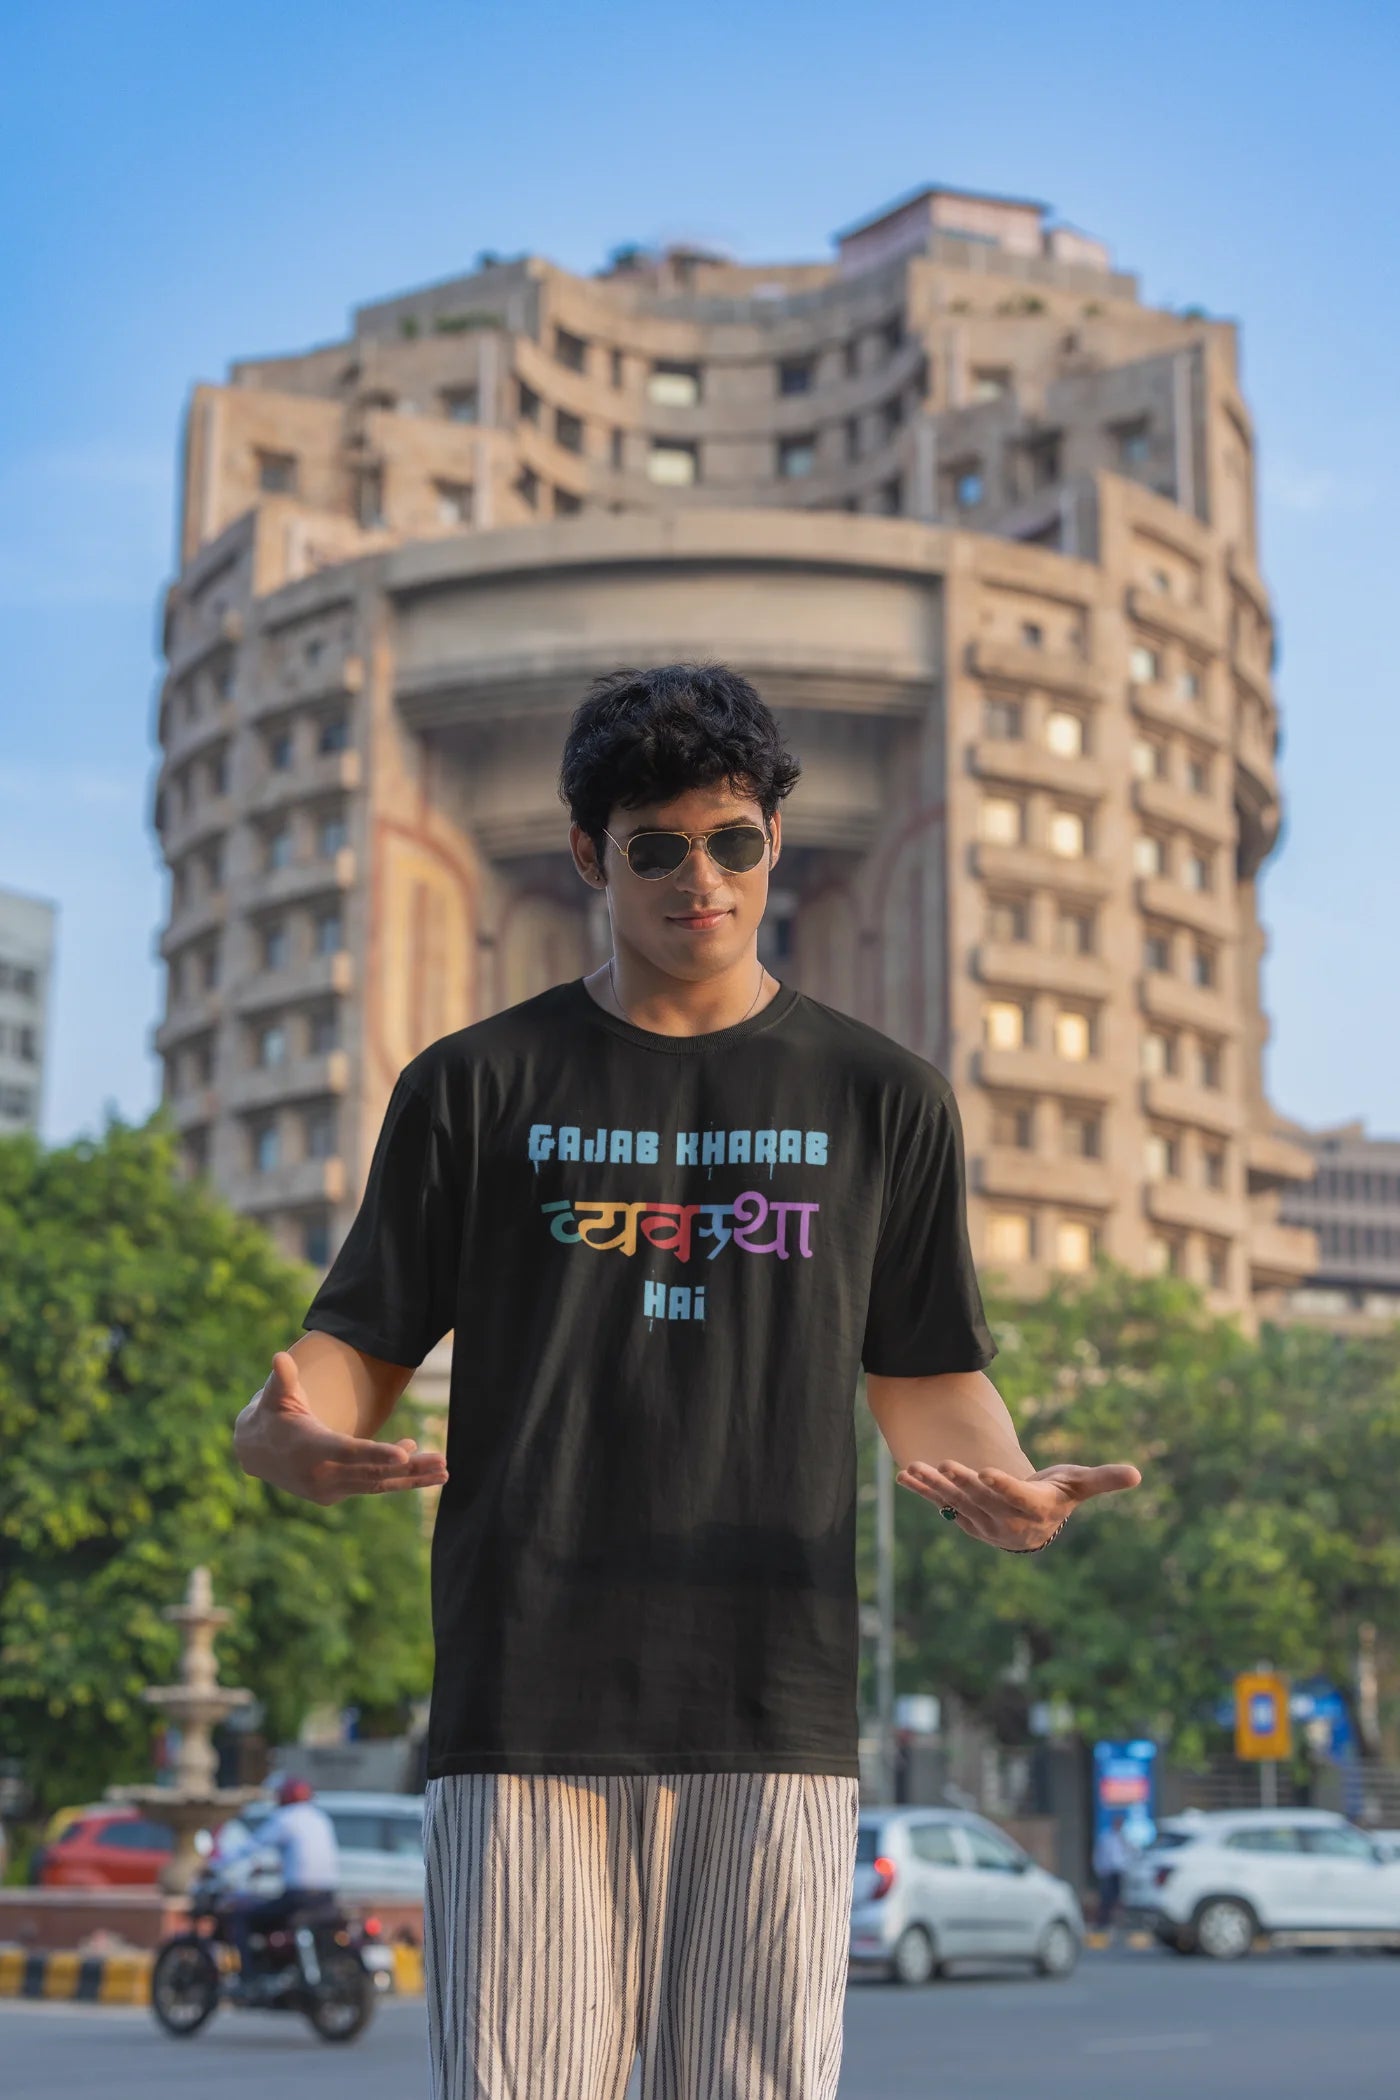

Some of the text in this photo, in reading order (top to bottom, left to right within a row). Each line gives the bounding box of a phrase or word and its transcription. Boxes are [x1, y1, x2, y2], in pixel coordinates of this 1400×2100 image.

[528, 1124, 828, 1173] GAJAB KHARAB
[541, 1191, 820, 1263] व्यवस्था
